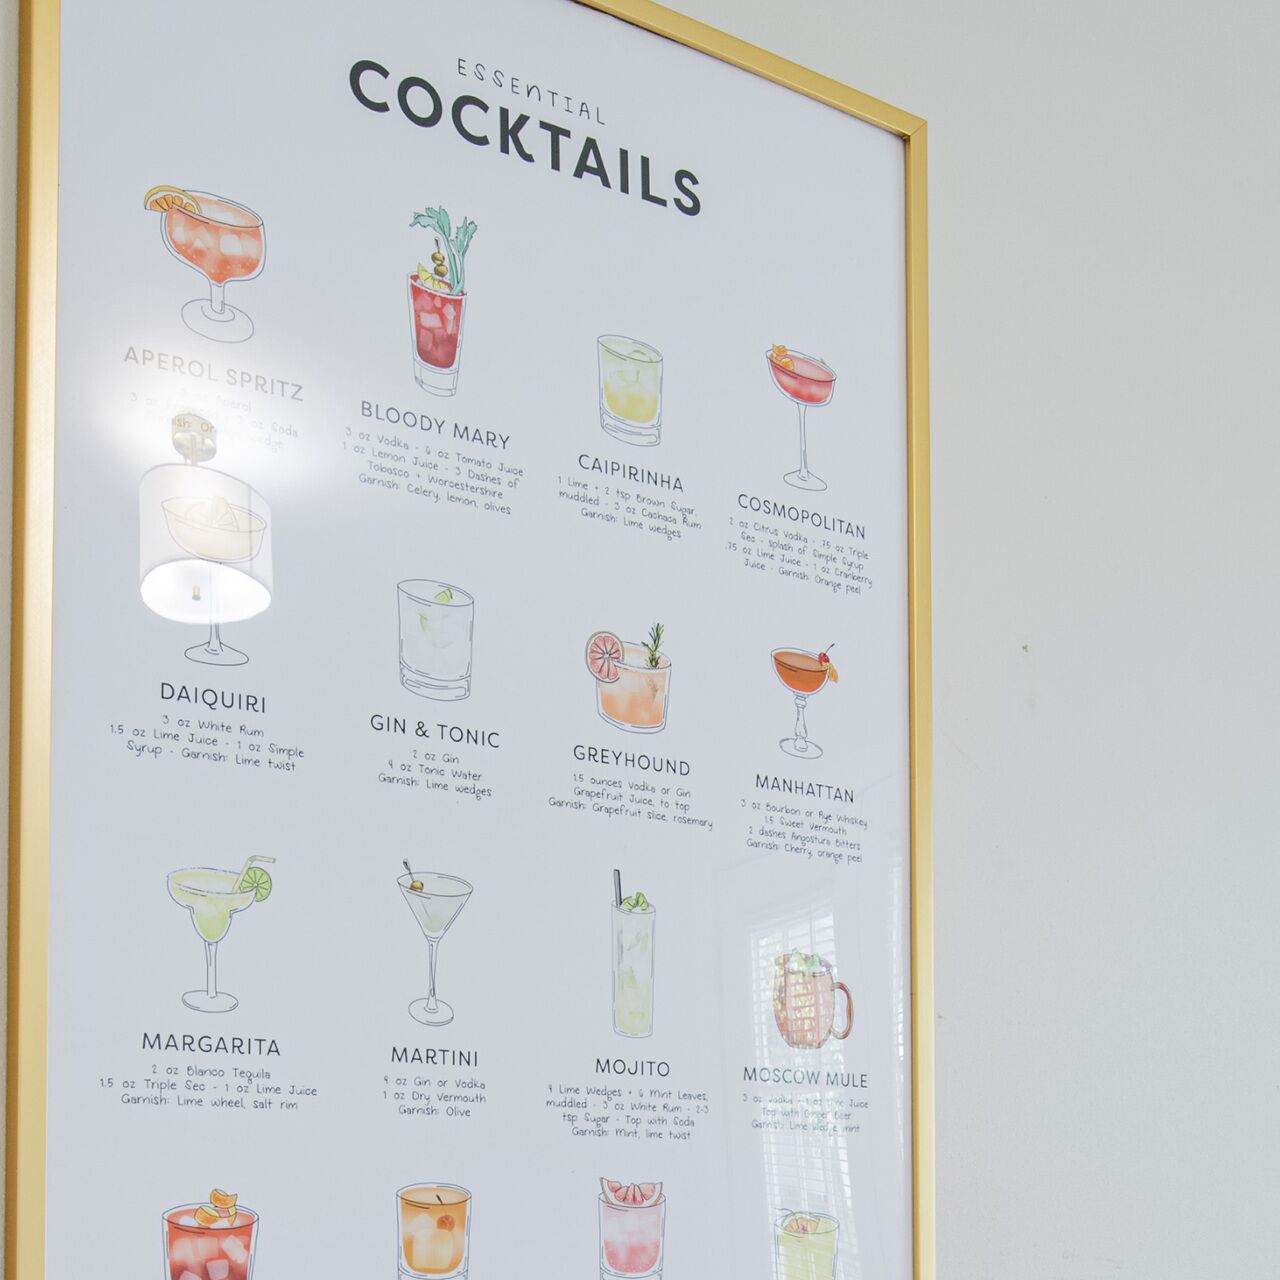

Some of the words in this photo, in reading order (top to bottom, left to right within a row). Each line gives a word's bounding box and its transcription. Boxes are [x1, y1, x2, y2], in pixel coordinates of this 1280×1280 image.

[457, 58, 605, 125] ESSENTIAL
[349, 59, 701, 216] COCKTAILS
[124, 346, 218, 382] APEROL
[226, 369, 304, 402] SPRITZ
[361, 401, 445, 434] BLOODY
[453, 423, 510, 449] MARY
[579, 454, 683, 492] CAIPIRINHA
[407, 484, 440, 503] Celery,
[447, 492, 478, 508] lemon,
[484, 502, 511, 515] olives
[428, 476, 503, 499] Worcestershire
[738, 494, 865, 539] COSMOPOLITAN
[624, 517, 643, 529] Lime
[649, 525, 681, 541] wedges
[161, 682, 265, 713] DAIQUIRI
[178, 719, 190, 728] oz
[198, 720, 232, 733] White
[240, 725, 264, 737] Rum
[371, 714, 405, 734] GIN
[415, 721, 429, 738] &
[437, 724, 499, 748] TONIC
[110, 724, 123, 734] 1.5
[133, 728, 145, 737] oz
[154, 728, 180, 741] Lime
[188, 734, 218, 746] Juice
[249, 744, 261, 752] oz
[268, 743, 304, 760] Simple
[127, 740, 162, 759] Syrup
[236, 755, 260, 767] Lime
[268, 759, 296, 771] twist
[443, 754, 459, 763] Gin
[574, 745, 690, 776] GREYHOUND
[400, 764, 411, 772] oz
[419, 764, 445, 776] Tonic
[452, 770, 482, 781] Water
[427, 779, 448, 791] Lime
[455, 784, 492, 800] wedges
[756, 774, 854, 803] MANHATTAN
[142, 1032, 281, 1056] MARGARITA
[392, 1046, 478, 1067] MARTINI
[596, 1058, 670, 1077] MOJITO
[166, 1067, 179, 1075] oz
[187, 1066, 224, 1077] Blanco
[233, 1068, 270, 1084] Tequila
[744, 1066, 821, 1084] MOSCOW
[826, 1072, 868, 1088] MULE
[123, 1080, 135, 1088] oz
[144, 1079, 177, 1094] Triple
[185, 1080, 205, 1091] Sec
[237, 1084, 249, 1093] oz
[257, 1084, 281, 1095] Lime
[289, 1086, 317, 1096] Juice
[178, 1096, 203, 1106] Lime
[211, 1098, 246, 1109] wheel,
[253, 1099, 272, 1109] salt
[280, 1100, 298, 1109] rim
[446, 1106, 471, 1116] Olive
[646, 1130, 663, 1138] lime
[670, 1131, 691, 1140] twist
